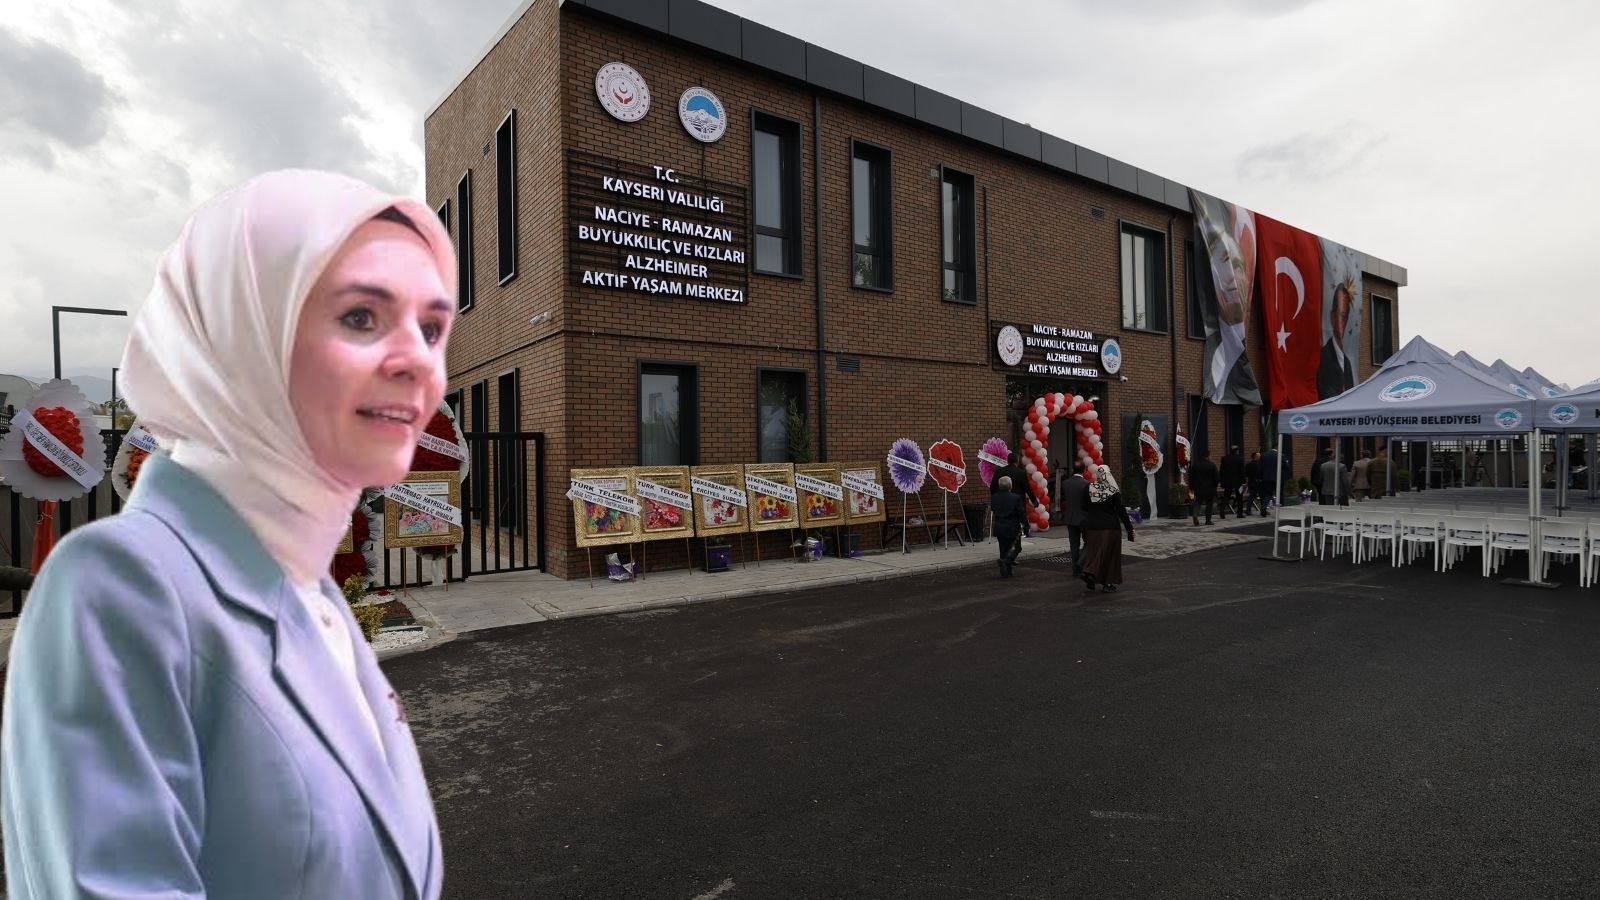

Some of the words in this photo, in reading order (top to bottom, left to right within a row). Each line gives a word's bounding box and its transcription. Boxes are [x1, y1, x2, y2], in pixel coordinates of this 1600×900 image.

[654, 166, 679, 182] T.C.
[662, 218, 732, 242] RAMAZAN
[673, 241, 691, 255] VE
[694, 244, 744, 263] KIZLARI
[631, 276, 682, 295] YAŞAM
[1062, 328, 1093, 340] RAMAZAN
[1066, 341, 1075, 351] VE
[1075, 342, 1099, 353] KIZLARI
[1049, 365, 1071, 376] YAŞAM
[1319, 416, 1356, 427] KAYSERİ
[1358, 415, 1418, 427] BÜYÜKŞEHİR
[1421, 414, 1481, 425] BELEDİYESİ
[598, 488, 634, 504] TELEKOM
[660, 487, 689, 500] TELEKOM
